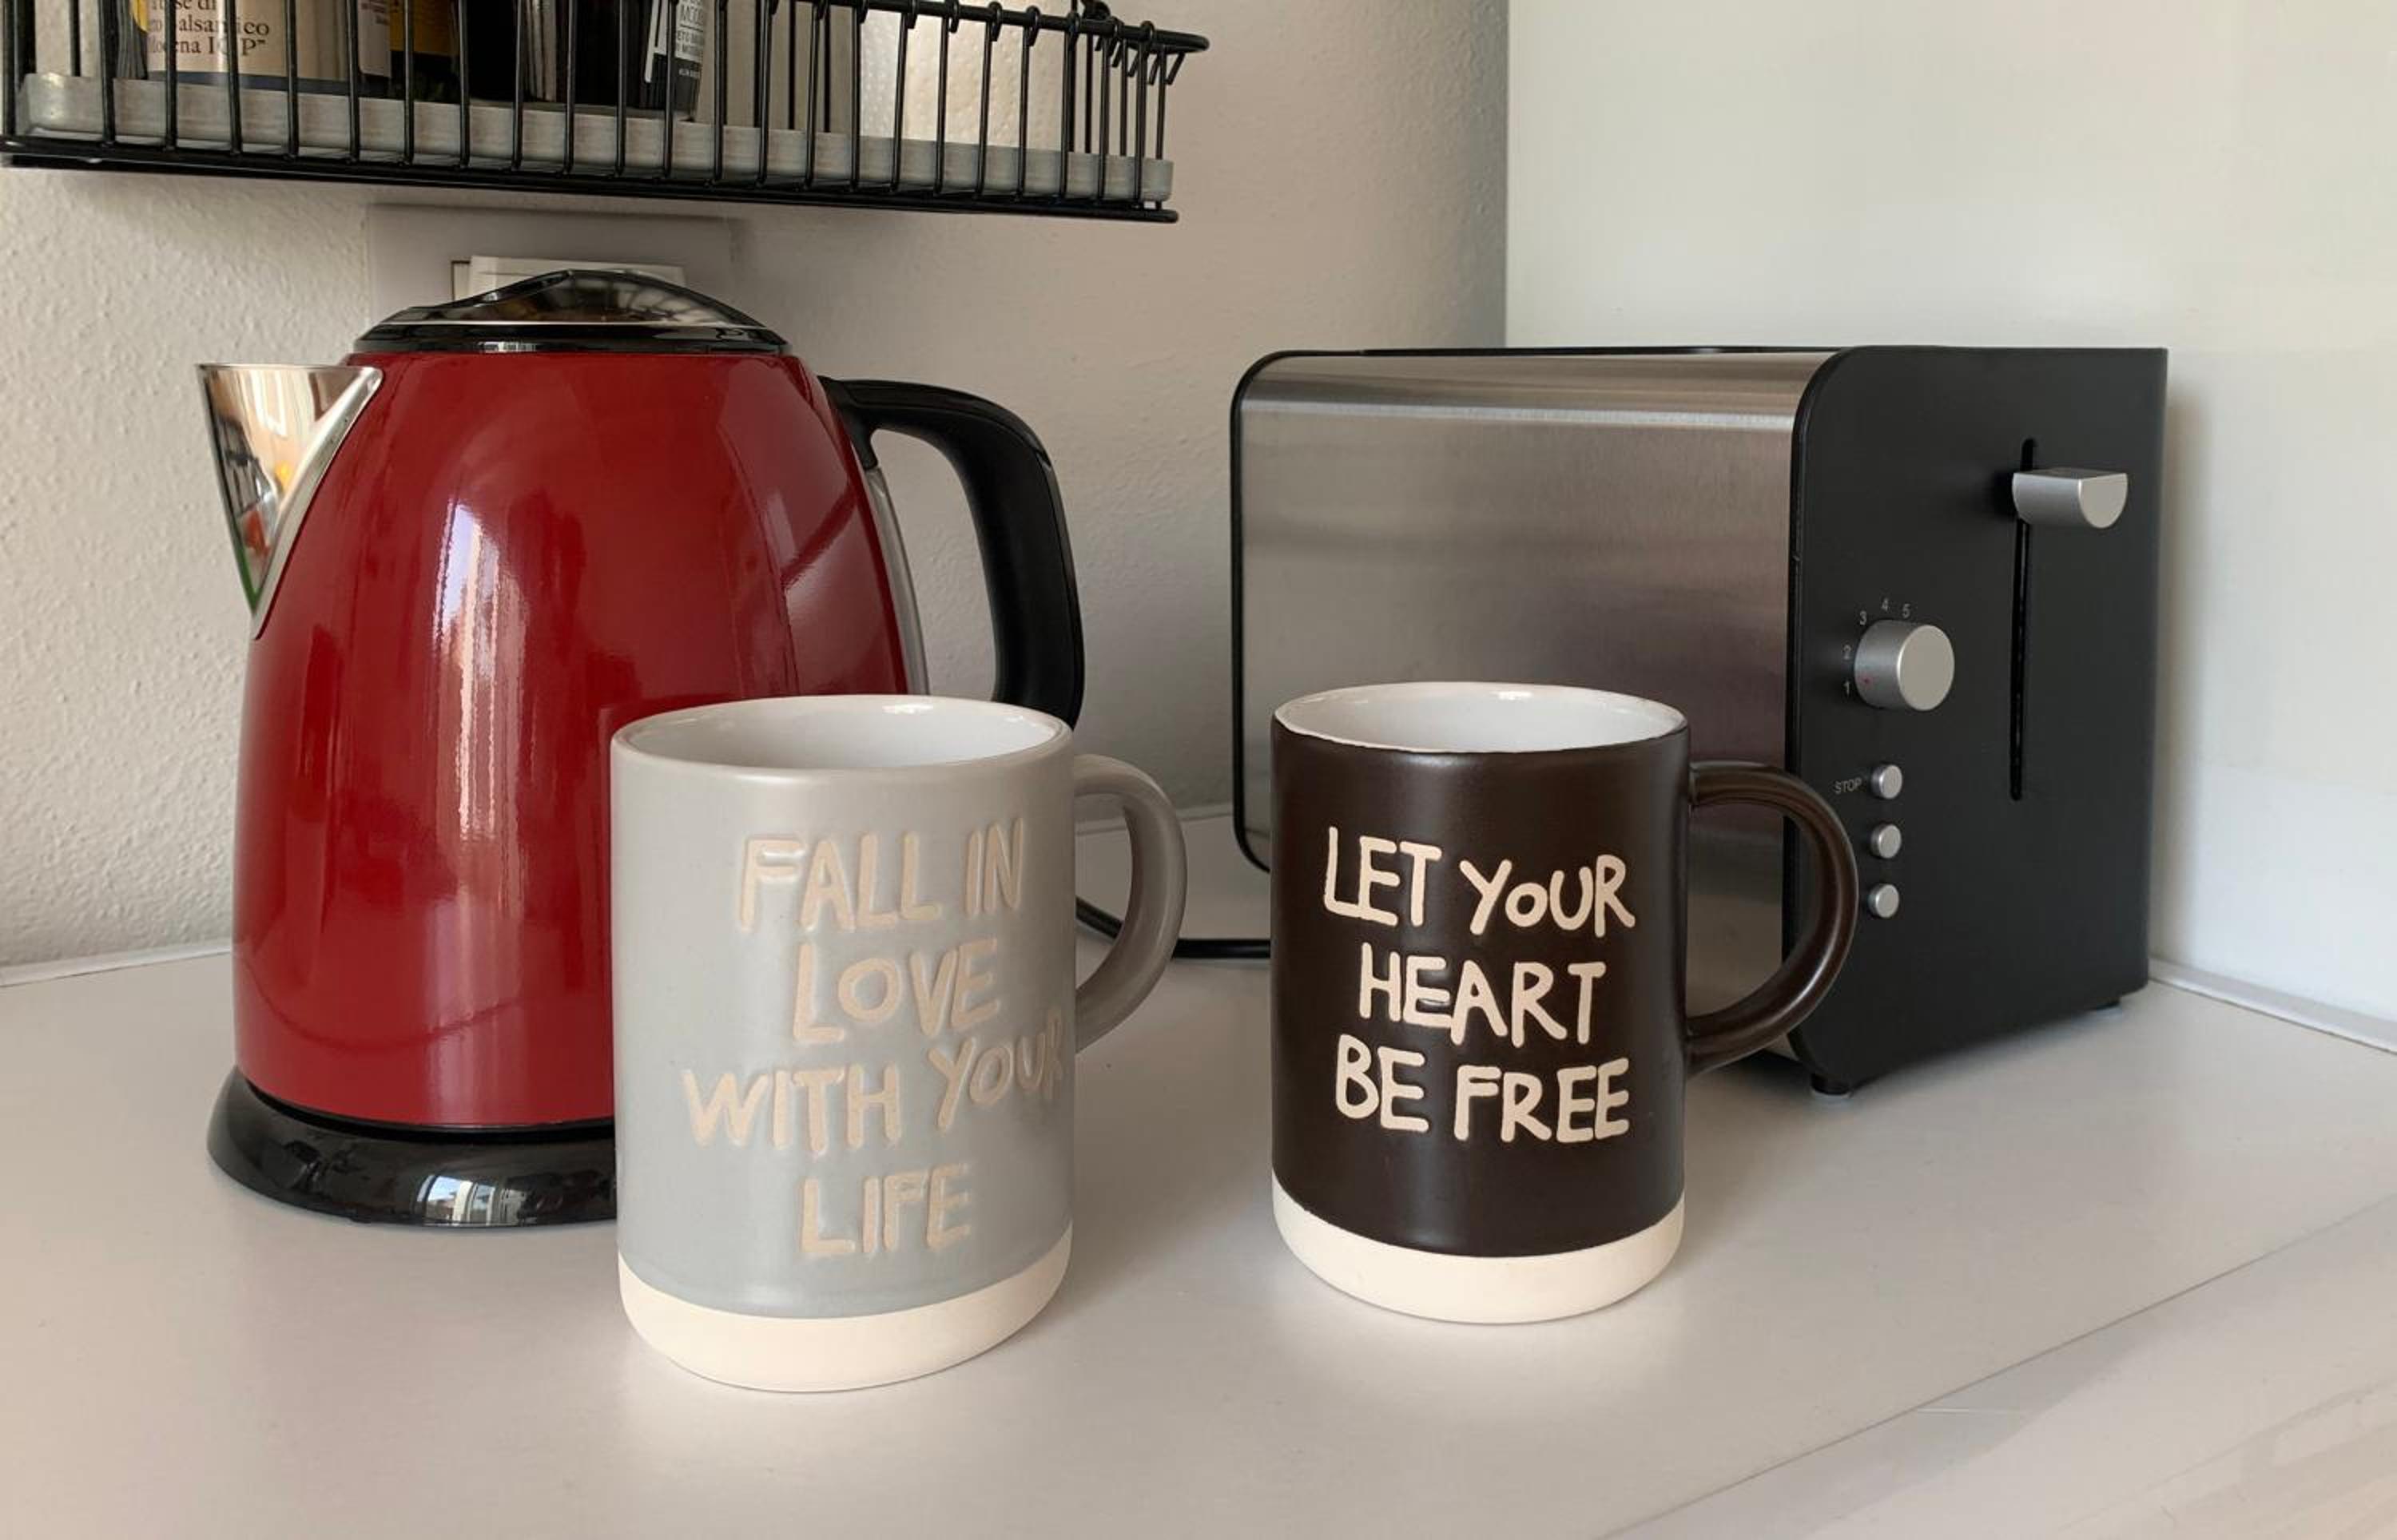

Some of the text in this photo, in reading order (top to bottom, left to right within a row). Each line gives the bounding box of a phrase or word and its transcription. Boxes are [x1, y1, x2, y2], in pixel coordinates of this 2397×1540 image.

[1859, 610, 1867, 625] 3
[1882, 598, 1890, 612] 4
[1902, 603, 1910, 619] 5
[1843, 645, 1851, 661] 2
[1843, 681, 1850, 696] 1
[1835, 776, 1862, 795] STOP
[737, 818, 1024, 933] FALL IN
[1324, 826, 1636, 938] LET YOUR
[791, 938, 1001, 1045] LOVE
[1359, 942, 1607, 1048] HEART
[682, 1008, 1063, 1157] WITH YOUR
[1335, 1034, 1630, 1143] BE FREE
[800, 1163, 972, 1256] LIFE
